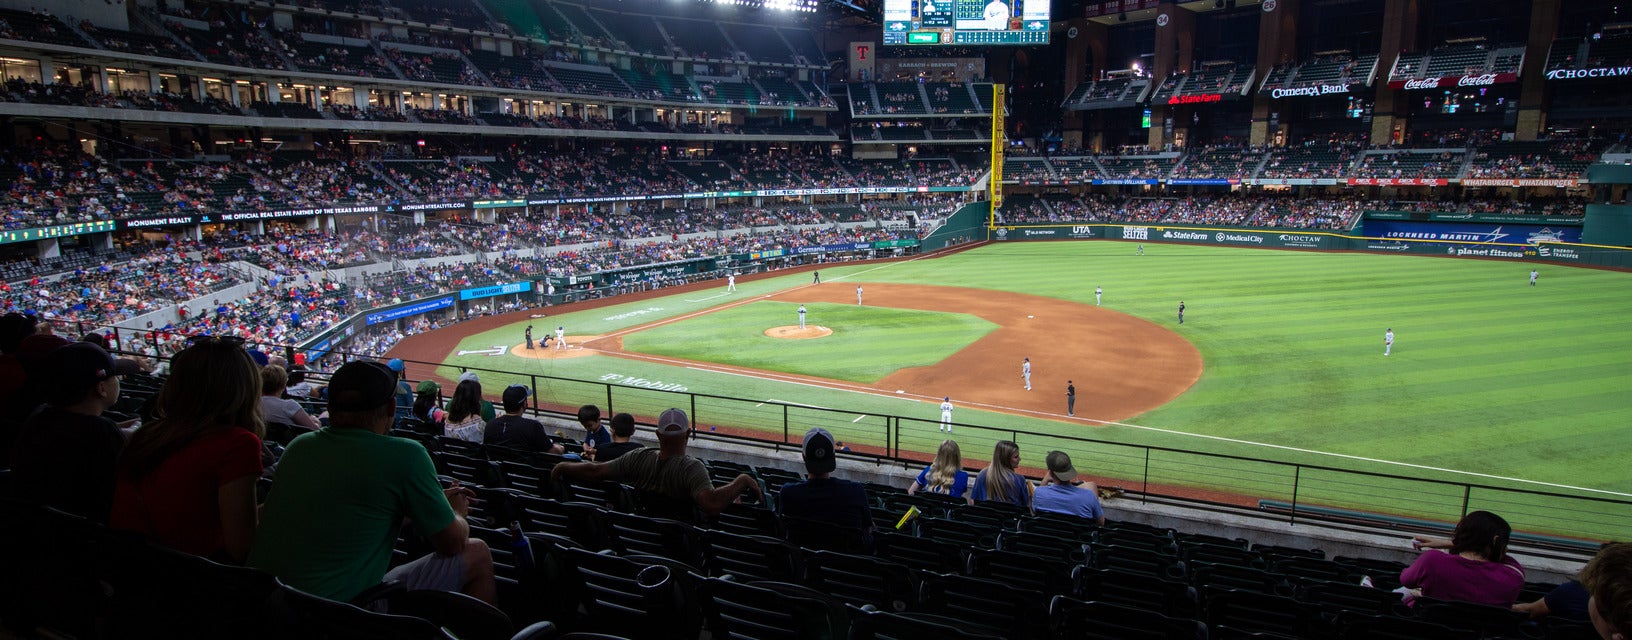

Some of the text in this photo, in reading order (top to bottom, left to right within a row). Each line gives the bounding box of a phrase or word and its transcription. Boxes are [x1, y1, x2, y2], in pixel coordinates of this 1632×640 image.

[1264, 1, 1274, 9] 26
[857, 46, 868, 60] T
[1554, 67, 1632, 80] CHOCTAW
[1322, 84, 1349, 94] Bank
[127, 219, 167, 227] MONUMENT
[1123, 230, 1148, 240] SELTZER
[1250, 236, 1263, 244] City
[1457, 248, 1524, 257] planet fitness
[502, 283, 520, 293] SELTZER
